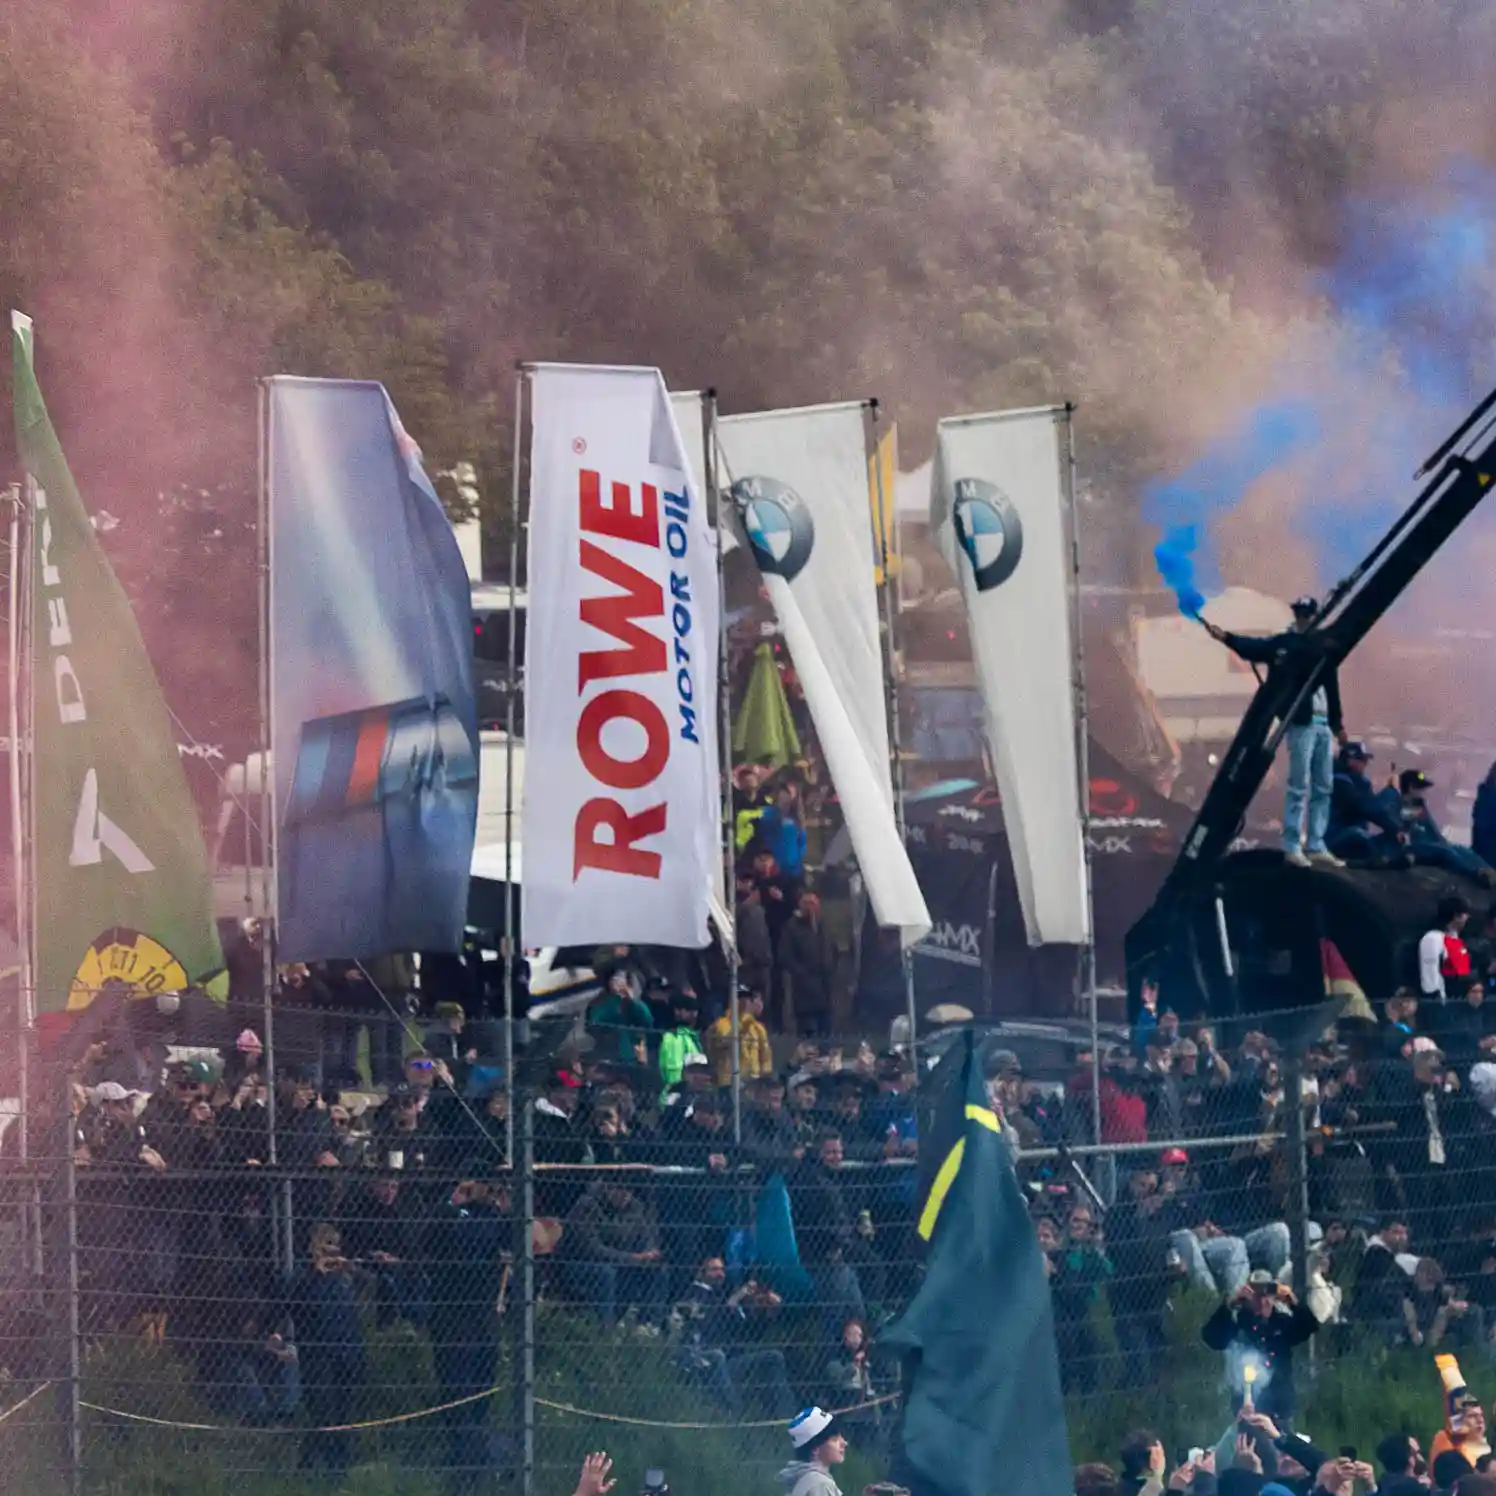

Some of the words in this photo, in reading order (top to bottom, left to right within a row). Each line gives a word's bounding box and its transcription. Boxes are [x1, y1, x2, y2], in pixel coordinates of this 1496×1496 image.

[663, 484, 691, 564] OIL
[573, 469, 671, 884] ROWE
[667, 576, 701, 745] MOTOR
